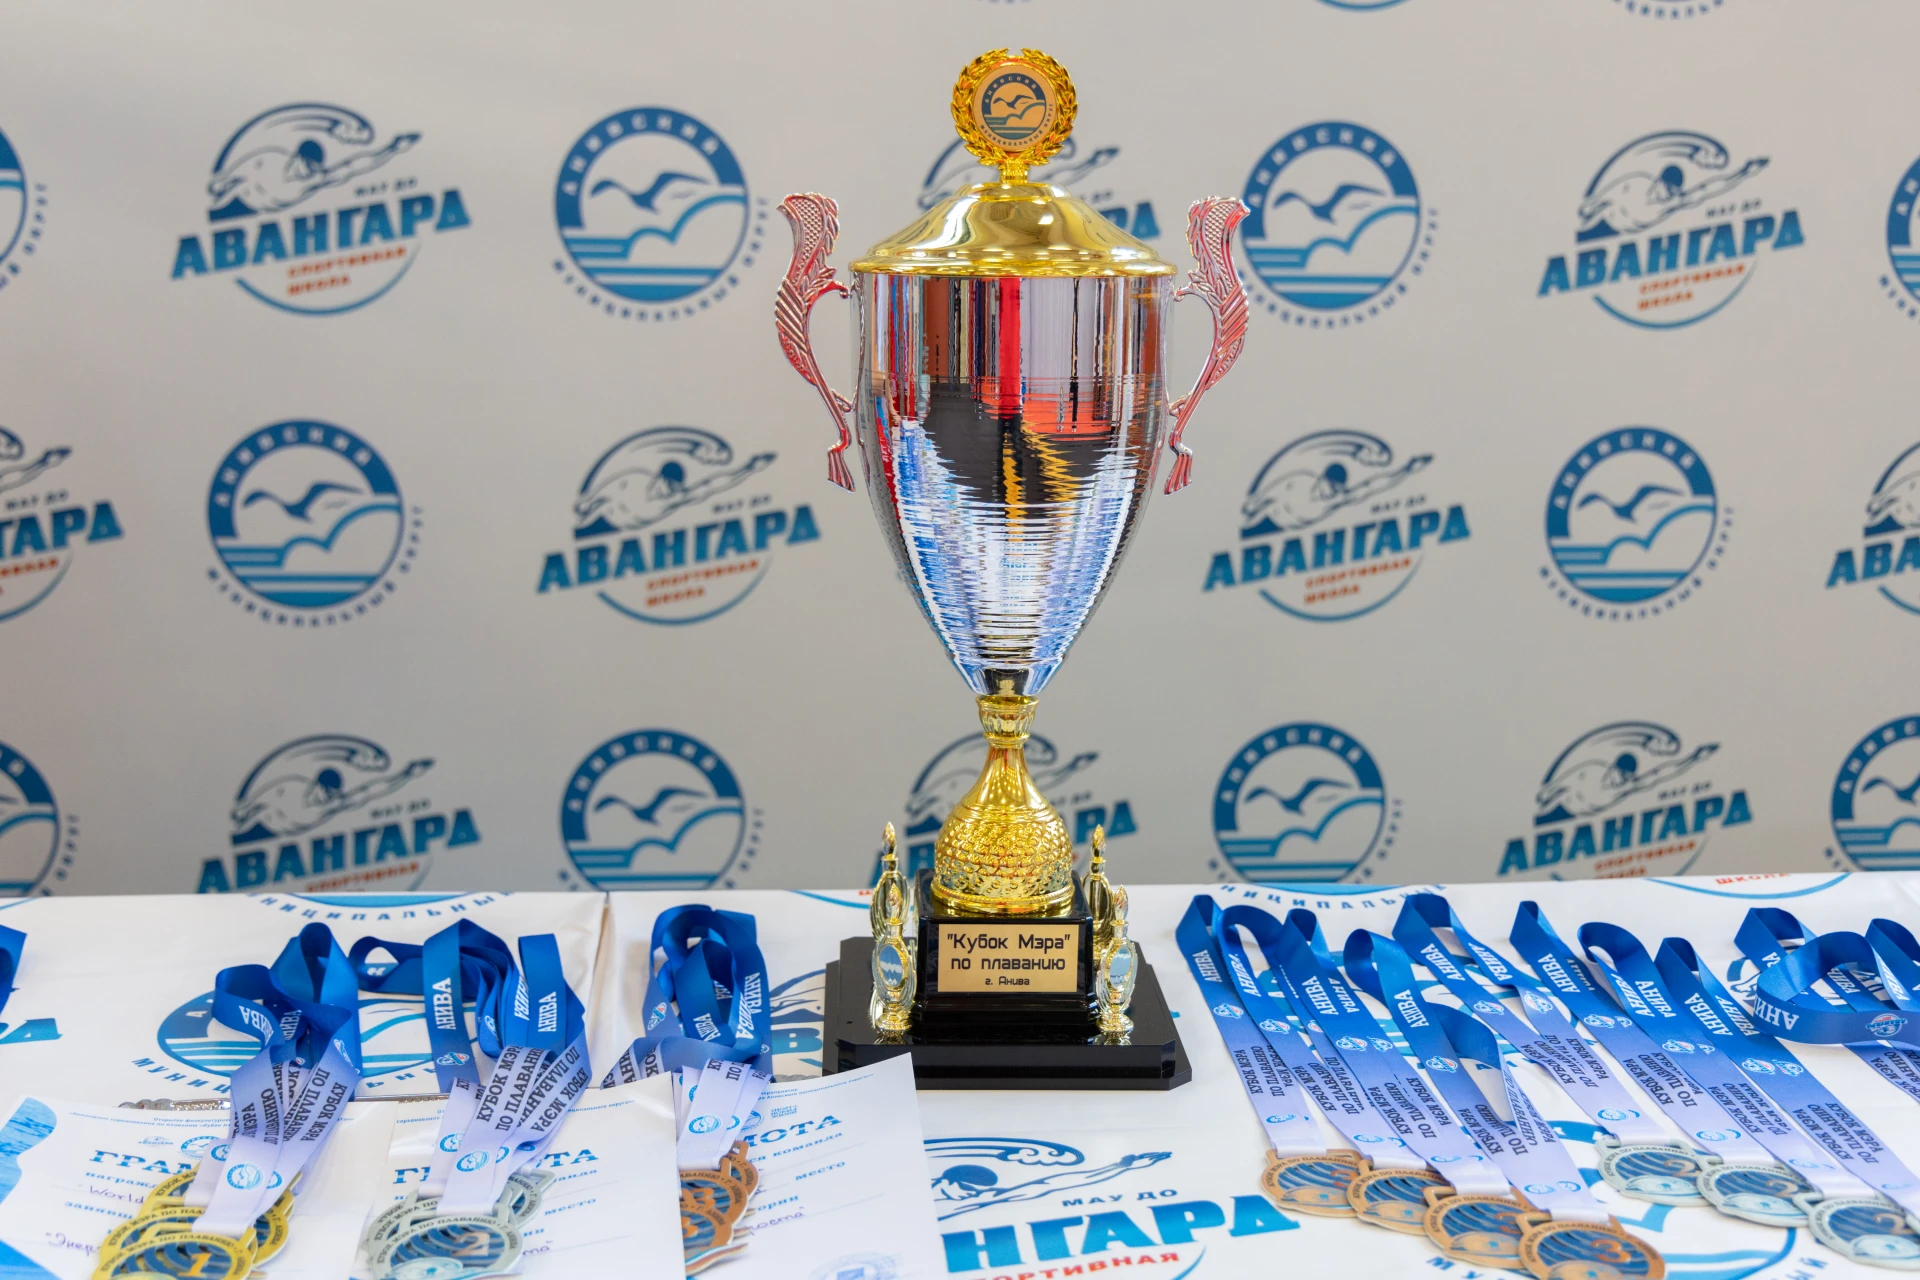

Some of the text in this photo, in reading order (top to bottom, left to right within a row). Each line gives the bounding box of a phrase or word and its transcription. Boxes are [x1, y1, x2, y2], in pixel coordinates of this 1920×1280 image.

[170, 188, 472, 280] АВАНГАРД
[1536, 208, 1805, 297] АВАНГАРД
[535, 503, 823, 596] АВАНГАРД
[1202, 503, 1471, 592] АВАНГАРД
[195, 807, 483, 893] АВАНГАРД
[1497, 789, 1753, 877] АВАНГАРД
[947, 933, 1071, 954] "Кубок Мэра"
[1420, 943, 1465, 981] АНИВА
[950, 956, 1066, 971] по плаванию
[998, 976, 1030, 986] Анива
[1192, 950, 1223, 983] АНИВА
[1538, 953, 1580, 993] АНИВА
[432, 977, 457, 1031] АНИВА
[537, 991, 557, 1032] АНИВА
[745, 972, 762, 1014] АНИВА
[1301, 975, 1339, 1016] АНИВА
[1394, 989, 1429, 1028] АНИВА
[1685, 992, 1733, 1036] АНИВА
[565, 1046, 580, 1065] ПО
[1234, 1049, 1263, 1094] КУБОК МЭРА
[1251, 1046, 1285, 1097] ПО ПЛАВАНИЮ
[1588, 1058, 1609, 1079] МЭРА
[1623, 1059, 1648, 1078] МЭРА
[1638, 1054, 1684, 1090] ПЛАВАНИЮ
[312, 1067, 330, 1088] ПО
[1292, 1066, 1337, 1112] КУБОК МЭРА
[1308, 1062, 1360, 1115] ПО ПЛАВАНИЮ
[1643, 1076, 1674, 1105] КУБОК
[317, 1082, 348, 1120] КУБОК
[476, 1073, 508, 1122] КУБОК
[530, 1067, 589, 1132] КУБОК МЭРА
[1368, 1086, 1413, 1135] КУБОК МЭРА
[1407, 1077, 1452, 1126] КУБОК МЭРА
[1677, 1090, 1698, 1107] ПО
[1708, 1087, 1734, 1109] МЭРА
[1723, 1083, 1770, 1127] ПЛАВАНИЮ
[495, 1115, 514, 1131] ПО
[1416, 1123, 1437, 1139] ПО
[1458, 1108, 1504, 1155] КУБОК МЭРА
[1793, 1109, 1854, 1160] КУБОК МЭРА
[1808, 1104, 1879, 1164] ПО ПЛАВАНИЮ
[1825, 1102, 1883, 1153] КУБОК МЭРА
[773, 1131, 843, 1158] команда
[1508, 1140, 1528, 1155] ПО
[795, 1161, 846, 1181] место
[1765, 1179, 1799, 1198] 2
[544, 1198, 597, 1216] место
[1062, 1189, 1178, 1208] МАУ ДО
[1874, 1213, 1914, 1235] 2
[452, 1232, 490, 1256] 2
[1591, 1239, 1632, 1263] 3
[178, 1253, 212, 1277] 1
[967, 1252, 1181, 1280] ОРТИВНАЯ
